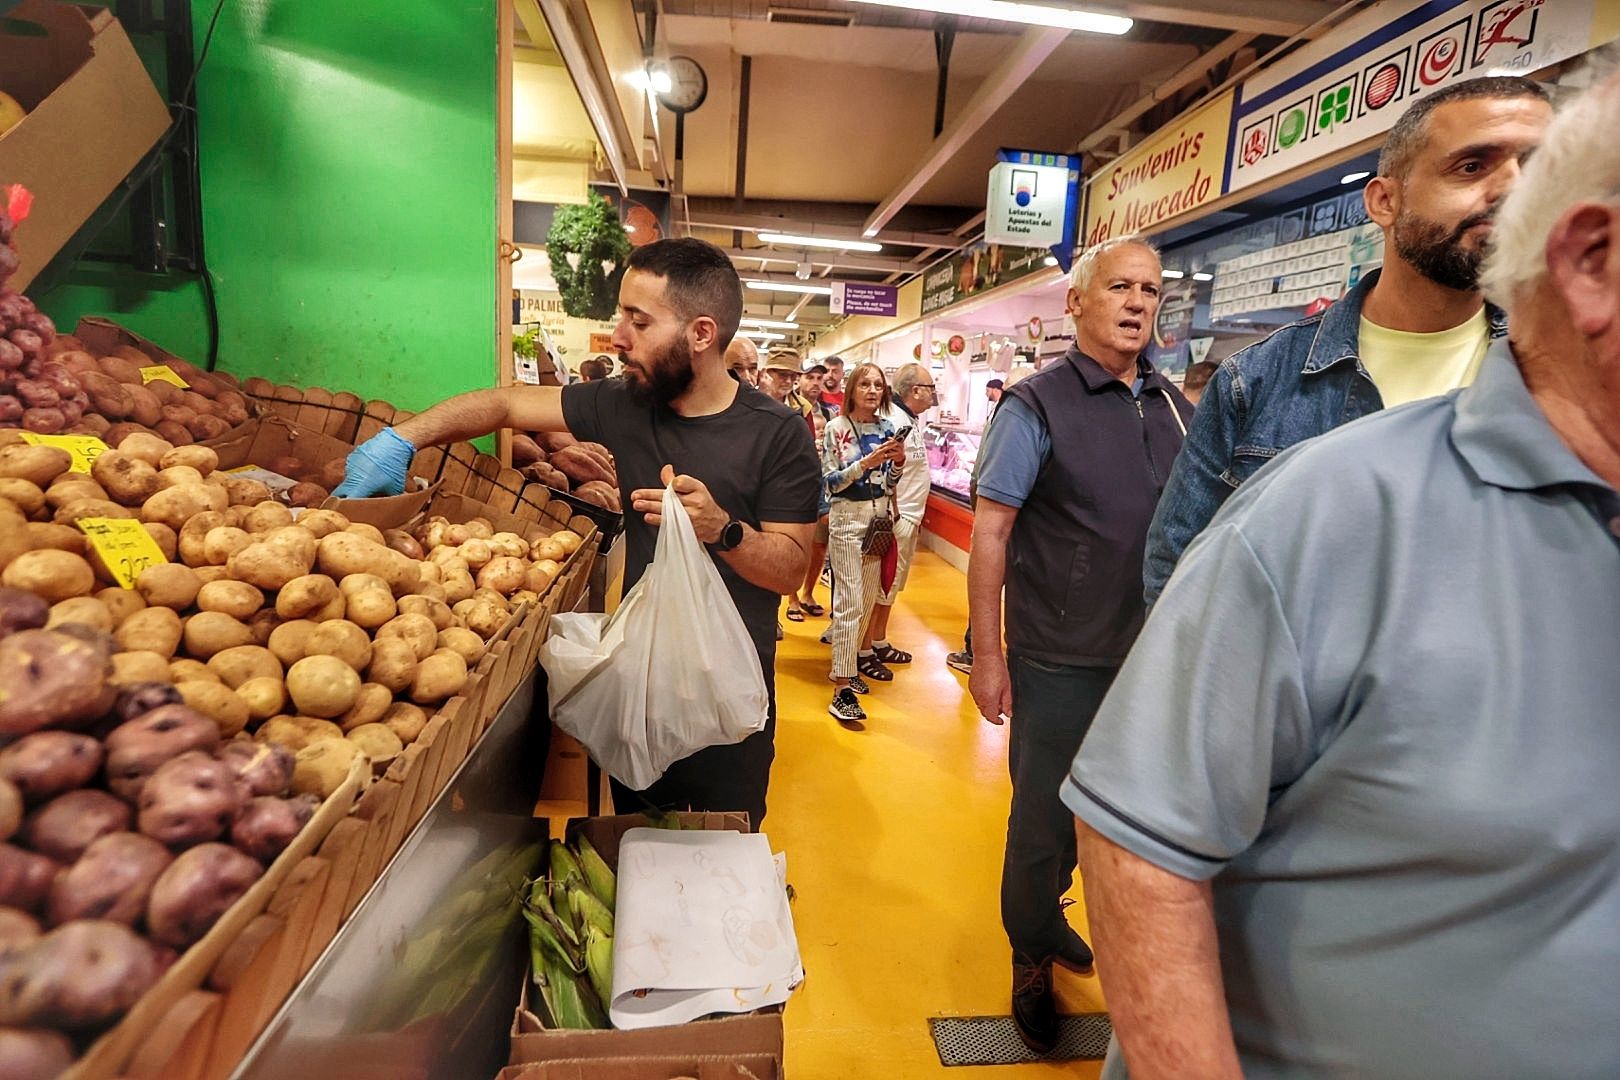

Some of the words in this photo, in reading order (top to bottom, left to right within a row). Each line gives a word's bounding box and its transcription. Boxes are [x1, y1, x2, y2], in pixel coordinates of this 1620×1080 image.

[1107, 130, 1204, 200] Souvenirs
[1088, 209, 1116, 248] del
[1120, 168, 1212, 235] Mercado
[1007, 225, 1031, 233] Estado
[1008, 217, 1039, 226] Apuestas
[528, 298, 563, 313] PALME
